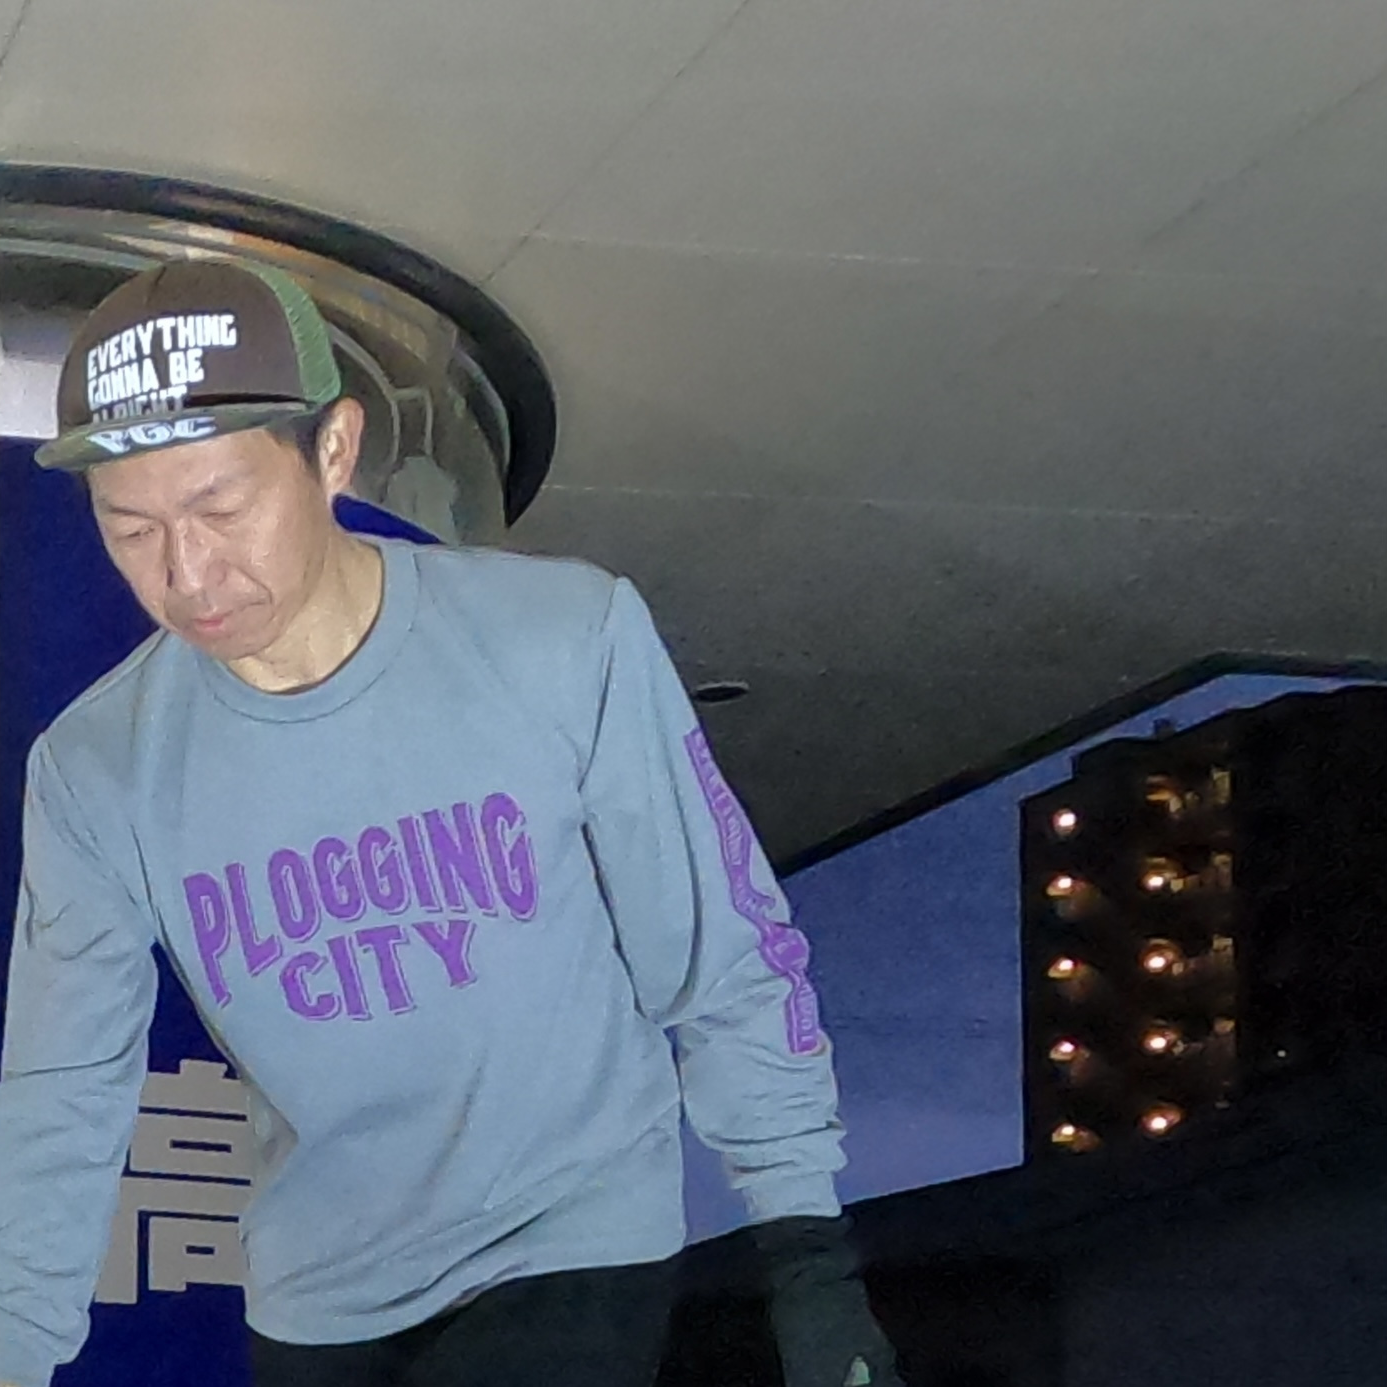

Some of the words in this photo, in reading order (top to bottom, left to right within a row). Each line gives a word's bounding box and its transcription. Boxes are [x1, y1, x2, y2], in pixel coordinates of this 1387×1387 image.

[87, 314, 237, 380] EVERYTHING
[88, 357, 160, 412] GONNA
[169, 348, 205, 385] BE
[183, 791, 539, 1009] PLOGGING
[279, 918, 477, 1022] CITY
